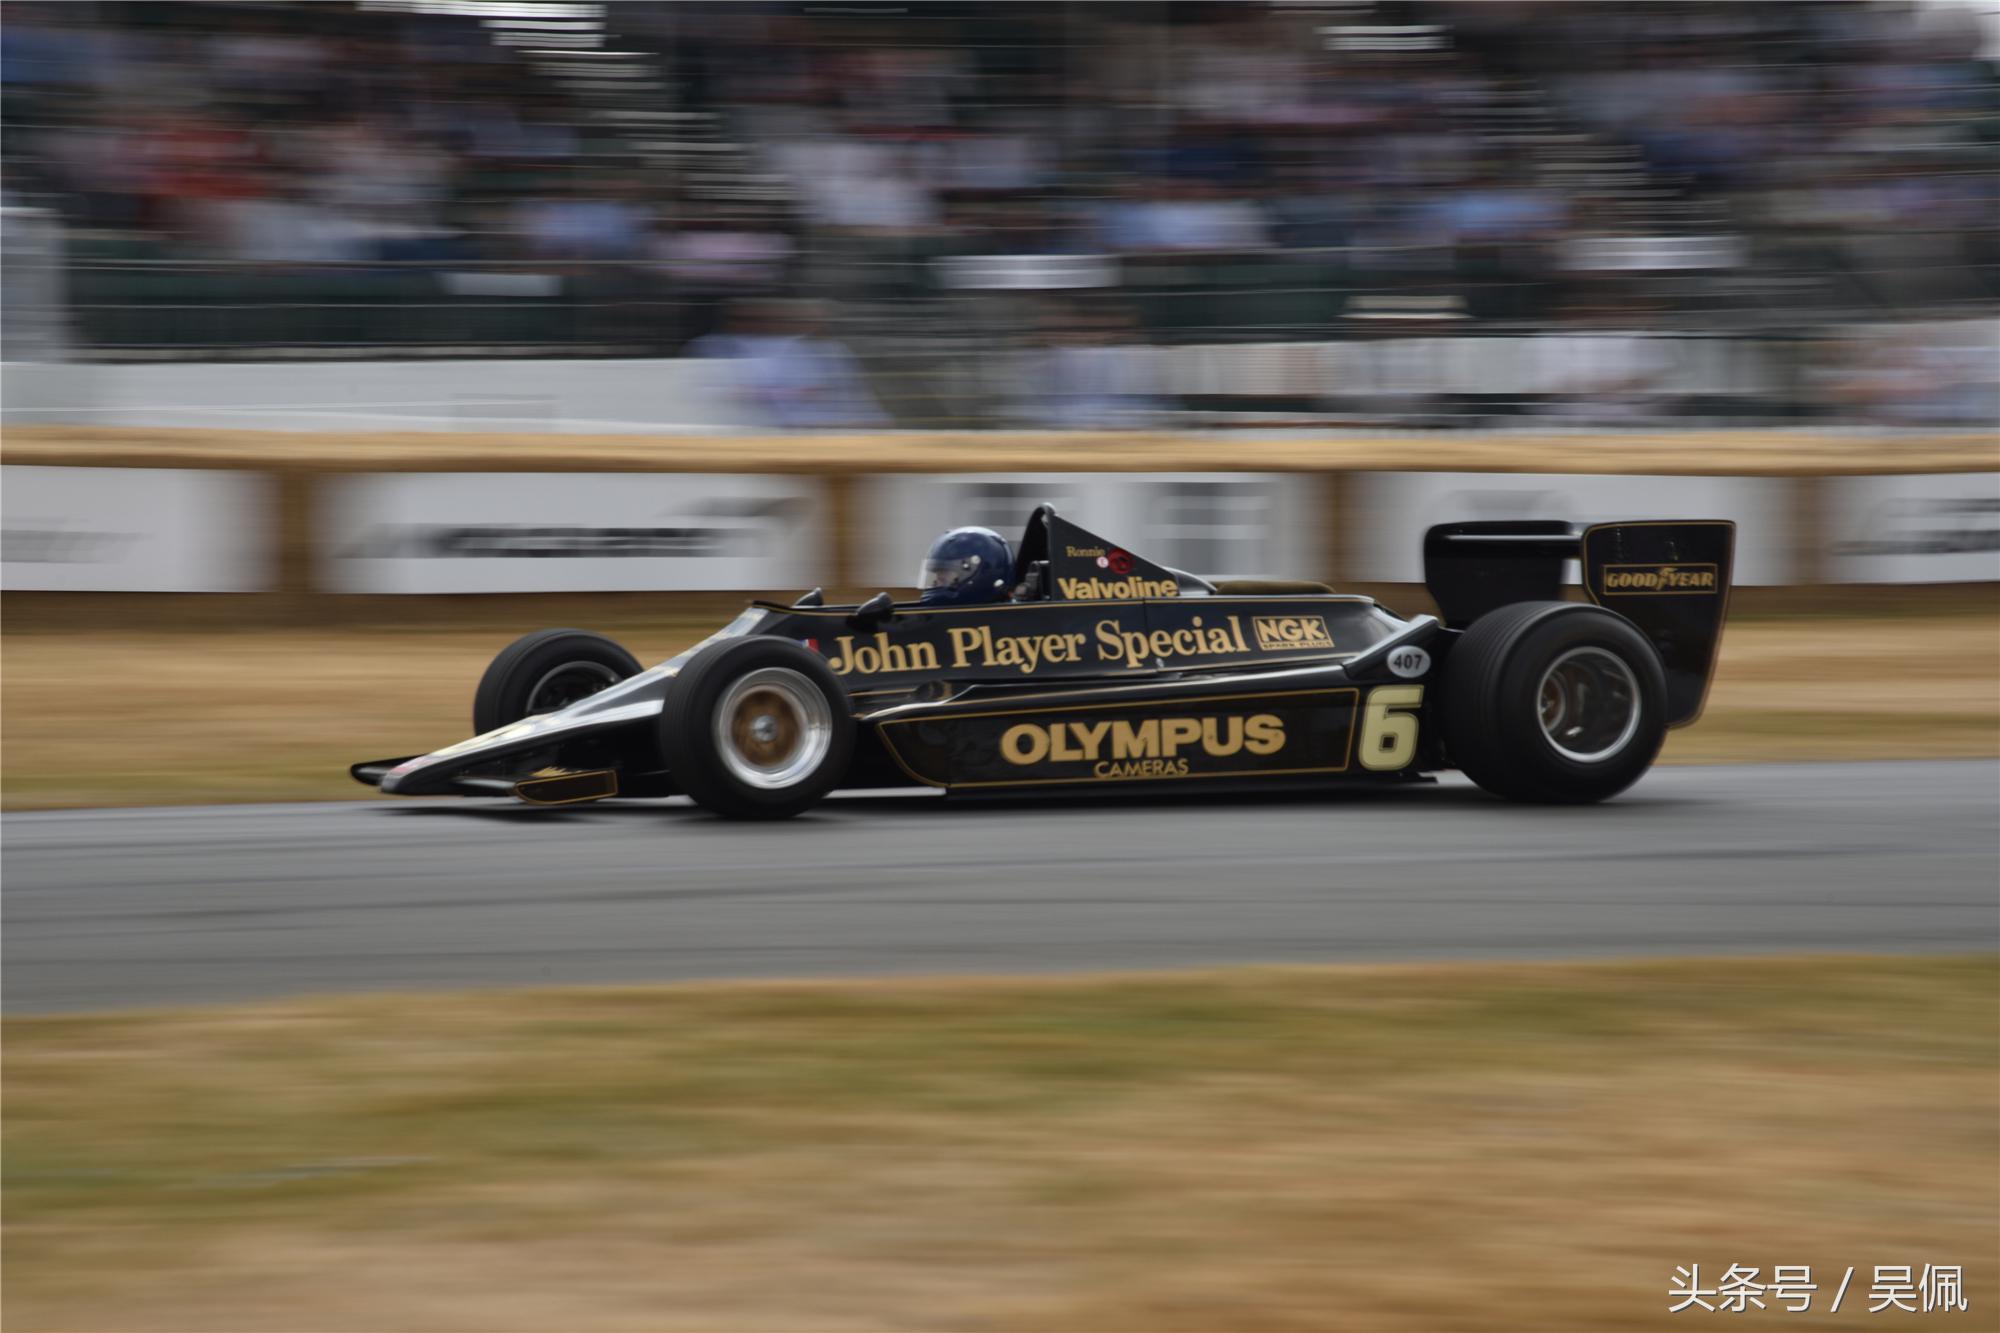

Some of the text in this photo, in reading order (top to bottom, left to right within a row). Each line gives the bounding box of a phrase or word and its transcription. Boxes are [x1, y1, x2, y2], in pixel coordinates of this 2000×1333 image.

[1058, 576, 1178, 599] Valvoline
[1257, 618, 1325, 642] NGK
[828, 615, 1250, 676] John Player Special
[1393, 653, 1423, 670] 407
[1358, 684, 1425, 771] 6
[1001, 714, 1286, 766] OLYMPUS
[1094, 758, 1190, 778] CAMERAS
